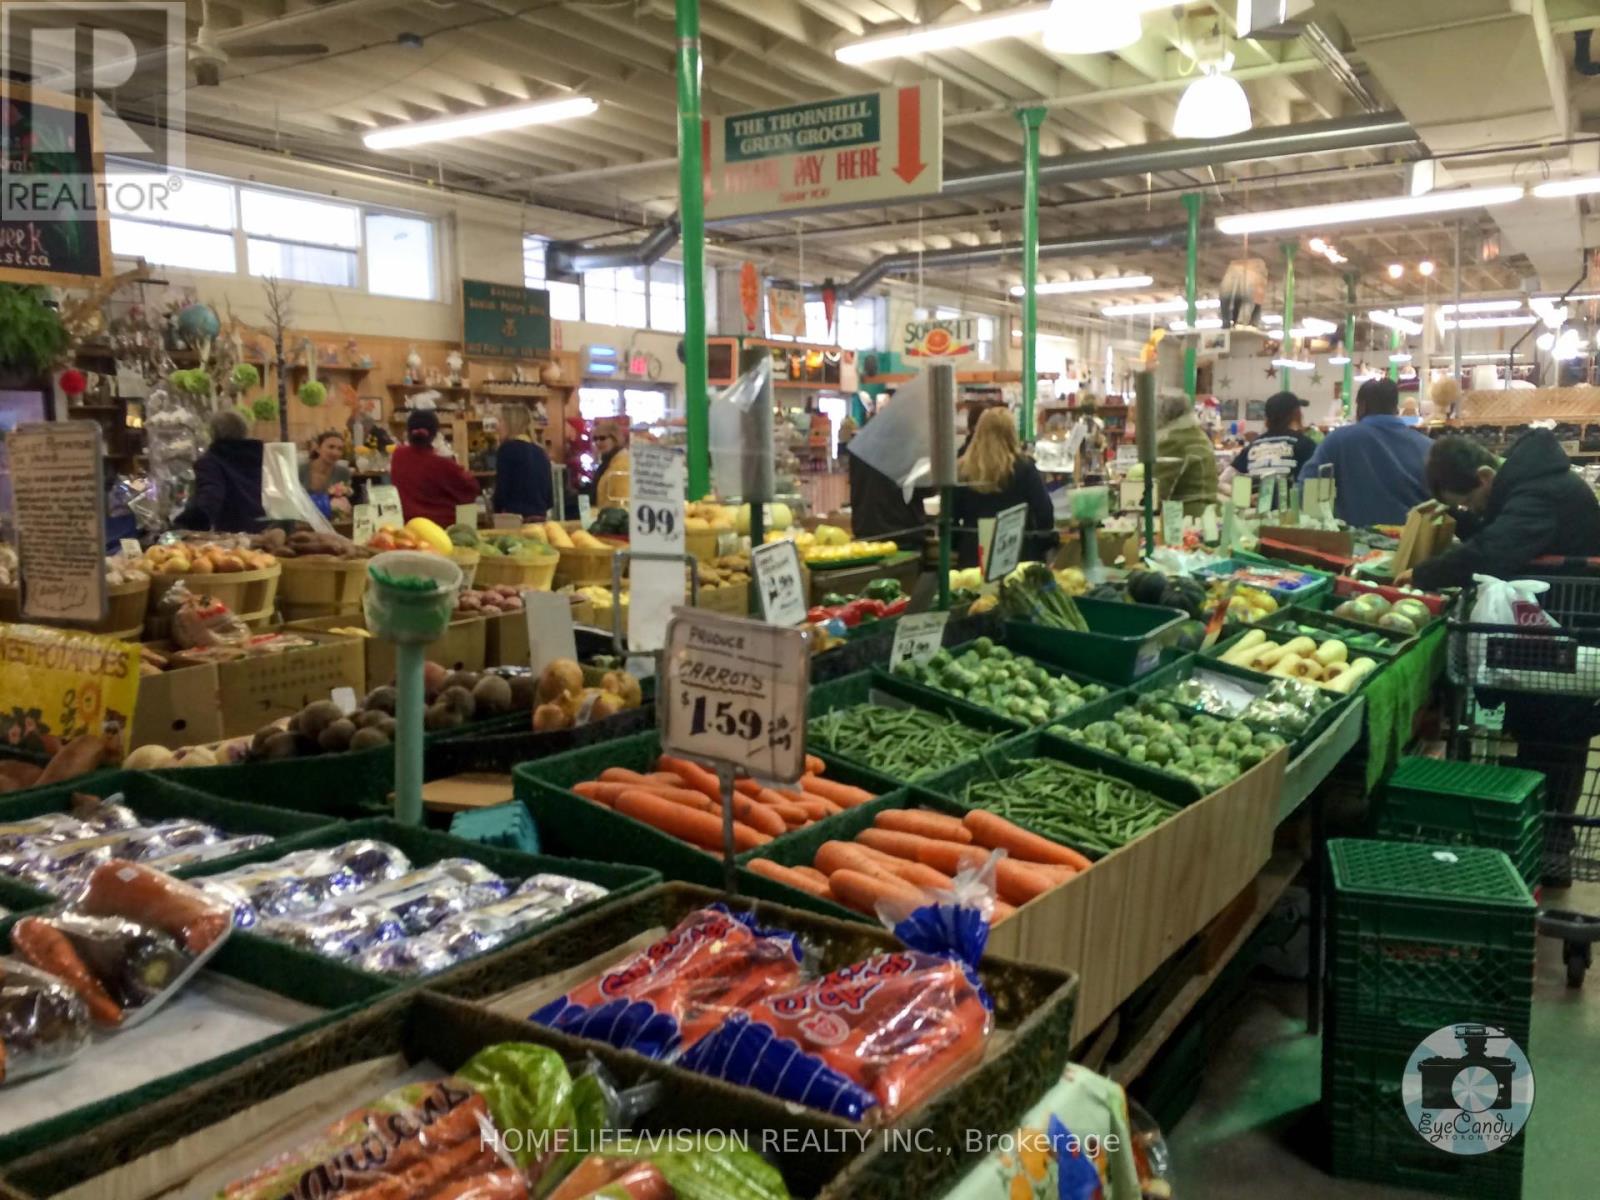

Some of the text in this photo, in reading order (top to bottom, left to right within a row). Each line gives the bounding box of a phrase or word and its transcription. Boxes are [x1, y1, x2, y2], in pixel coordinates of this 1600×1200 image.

[732, 101, 872, 137] THE THORNHILL
[740, 122, 864, 155] GREEN GROCER
[793, 155, 825, 187] PAY
[836, 147, 881, 181] HERE
[690, 626, 745, 650] PRODUCE
[679, 660, 763, 691] CARROTS
